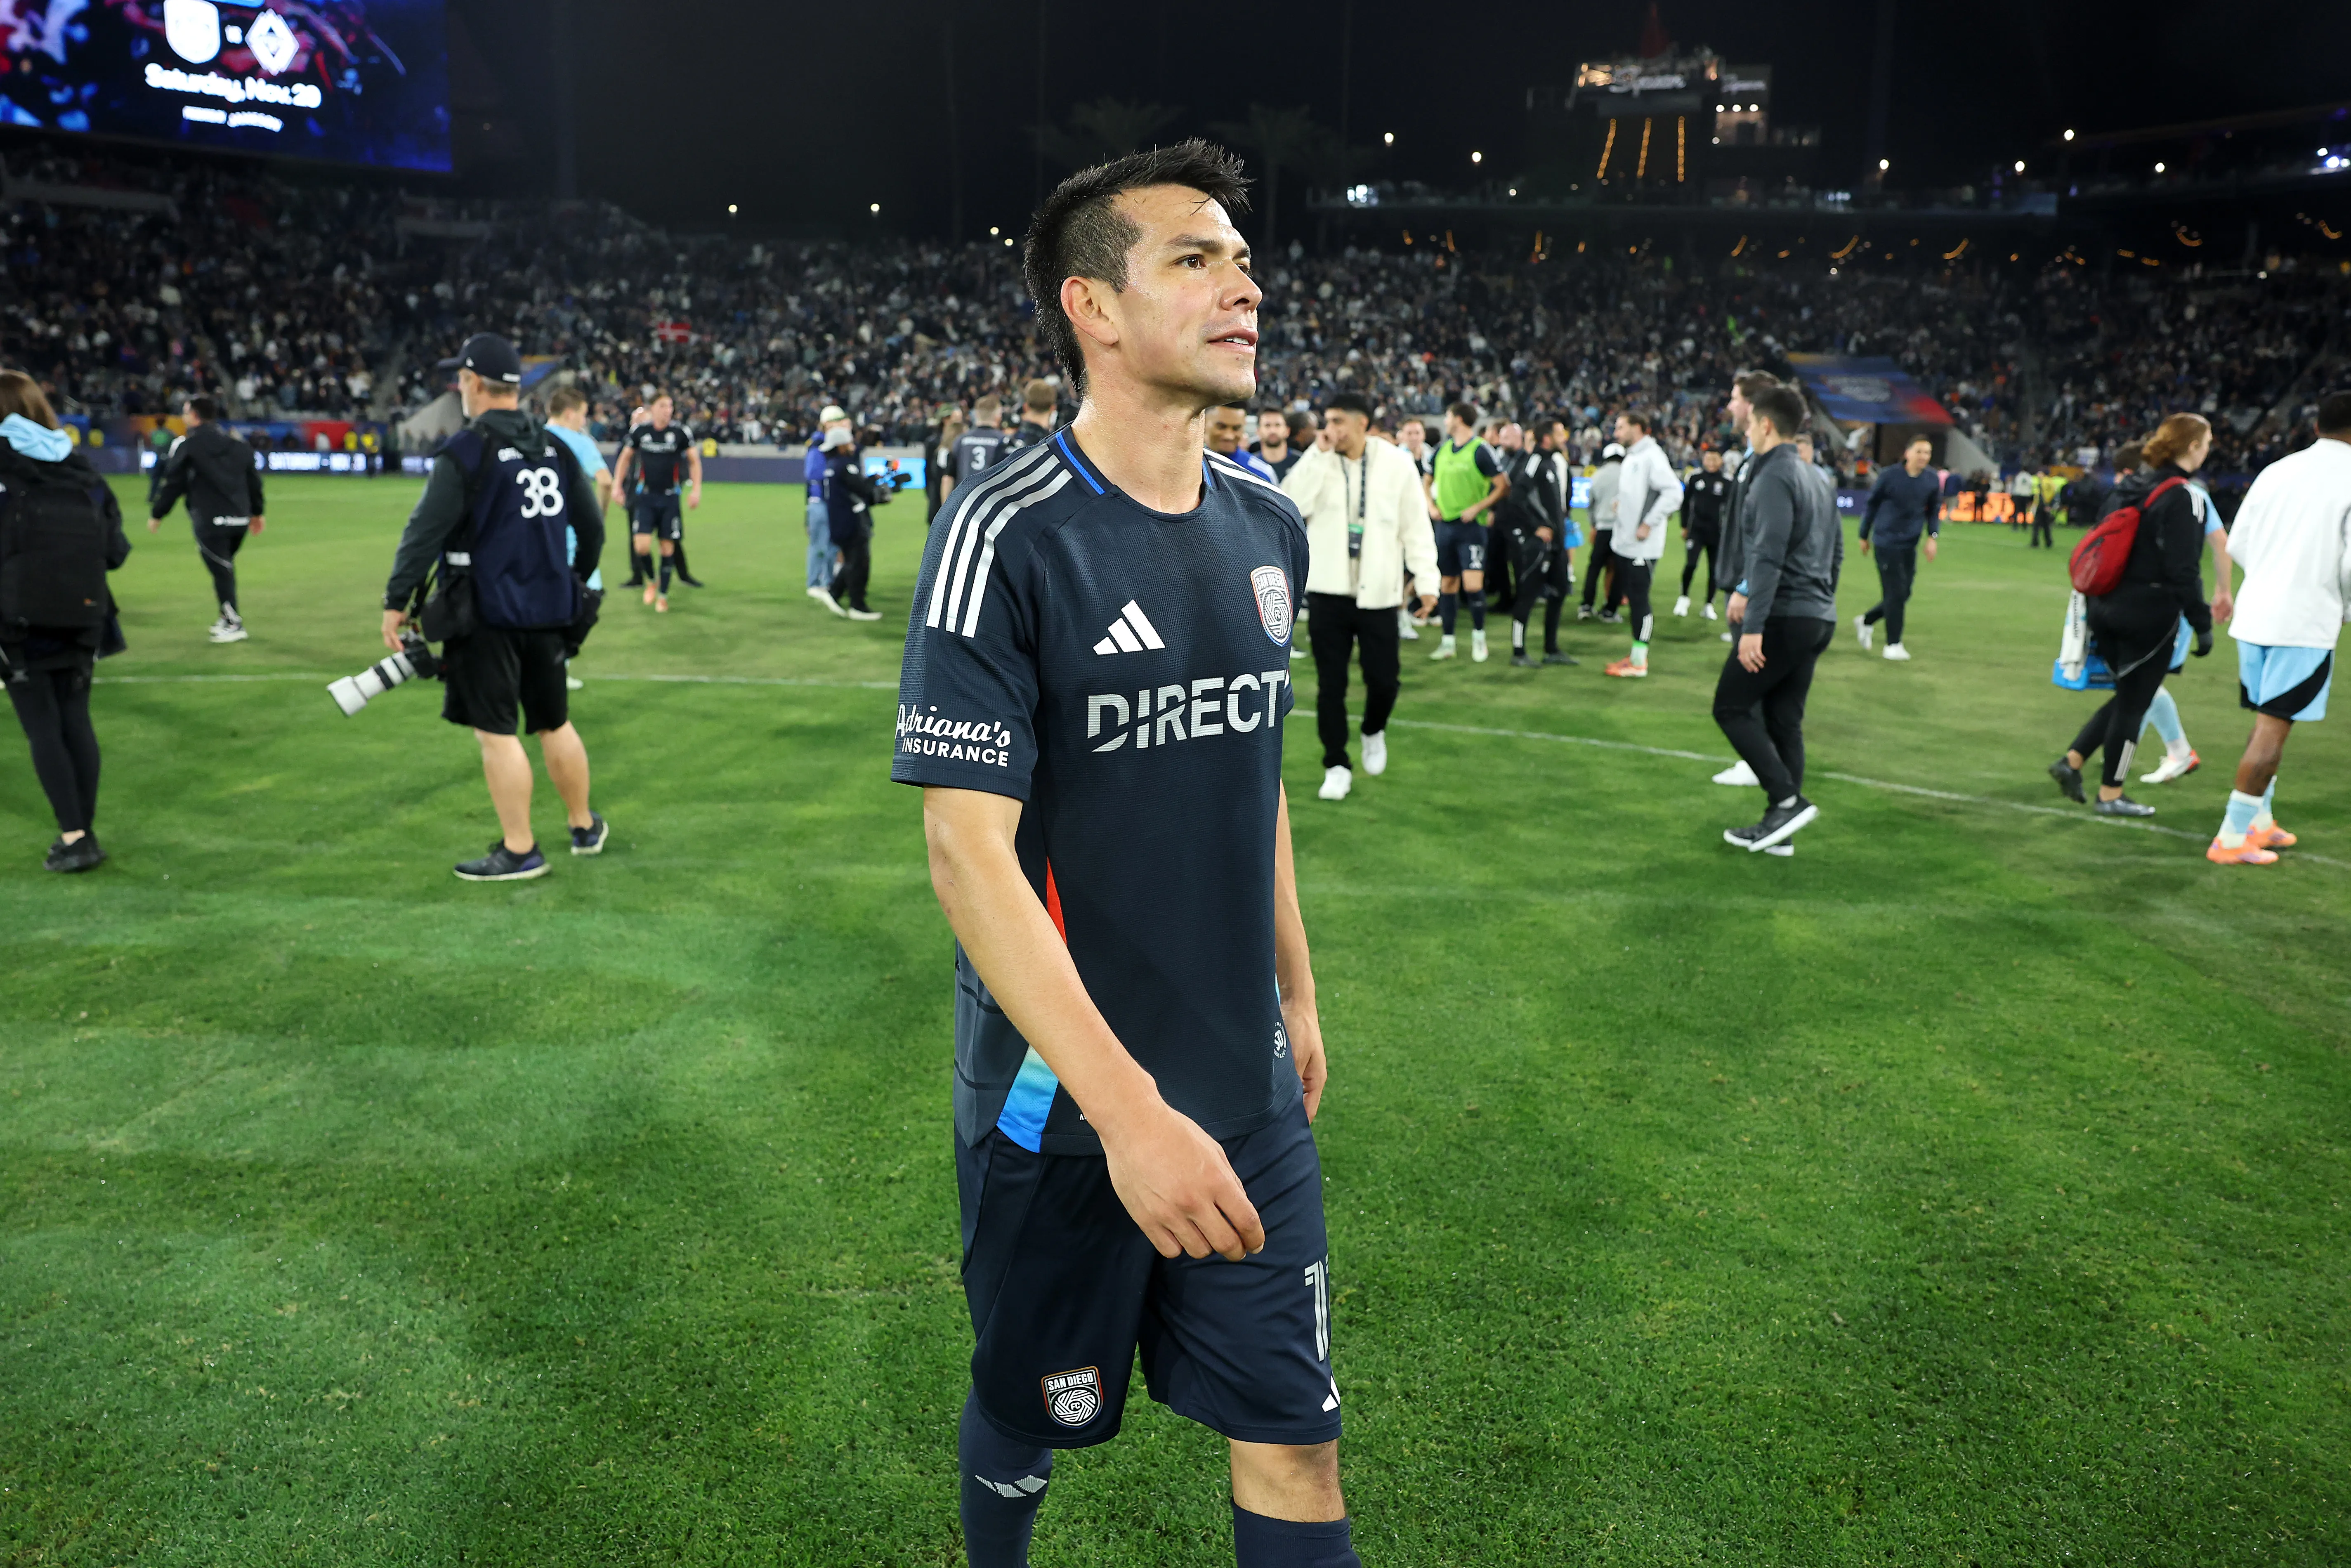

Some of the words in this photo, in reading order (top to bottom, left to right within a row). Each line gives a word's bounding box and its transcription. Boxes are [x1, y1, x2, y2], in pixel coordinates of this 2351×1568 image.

[971, 446, 986, 471] 3
[516, 466, 564, 519] 38
[1256, 574, 1268, 590] SAN
[1268, 573, 1284, 588] DIEGO
[895, 704, 1011, 748] Adriana's
[1087, 669, 1286, 753] DIRECT
[902, 737, 1009, 767] INSURANCE
[1304, 1253, 1329, 1362] 1
[1048, 1377, 1067, 1391] SAN
[1067, 1373, 1093, 1386] DIEGO
[1070, 1402, 1081, 1410] FC
